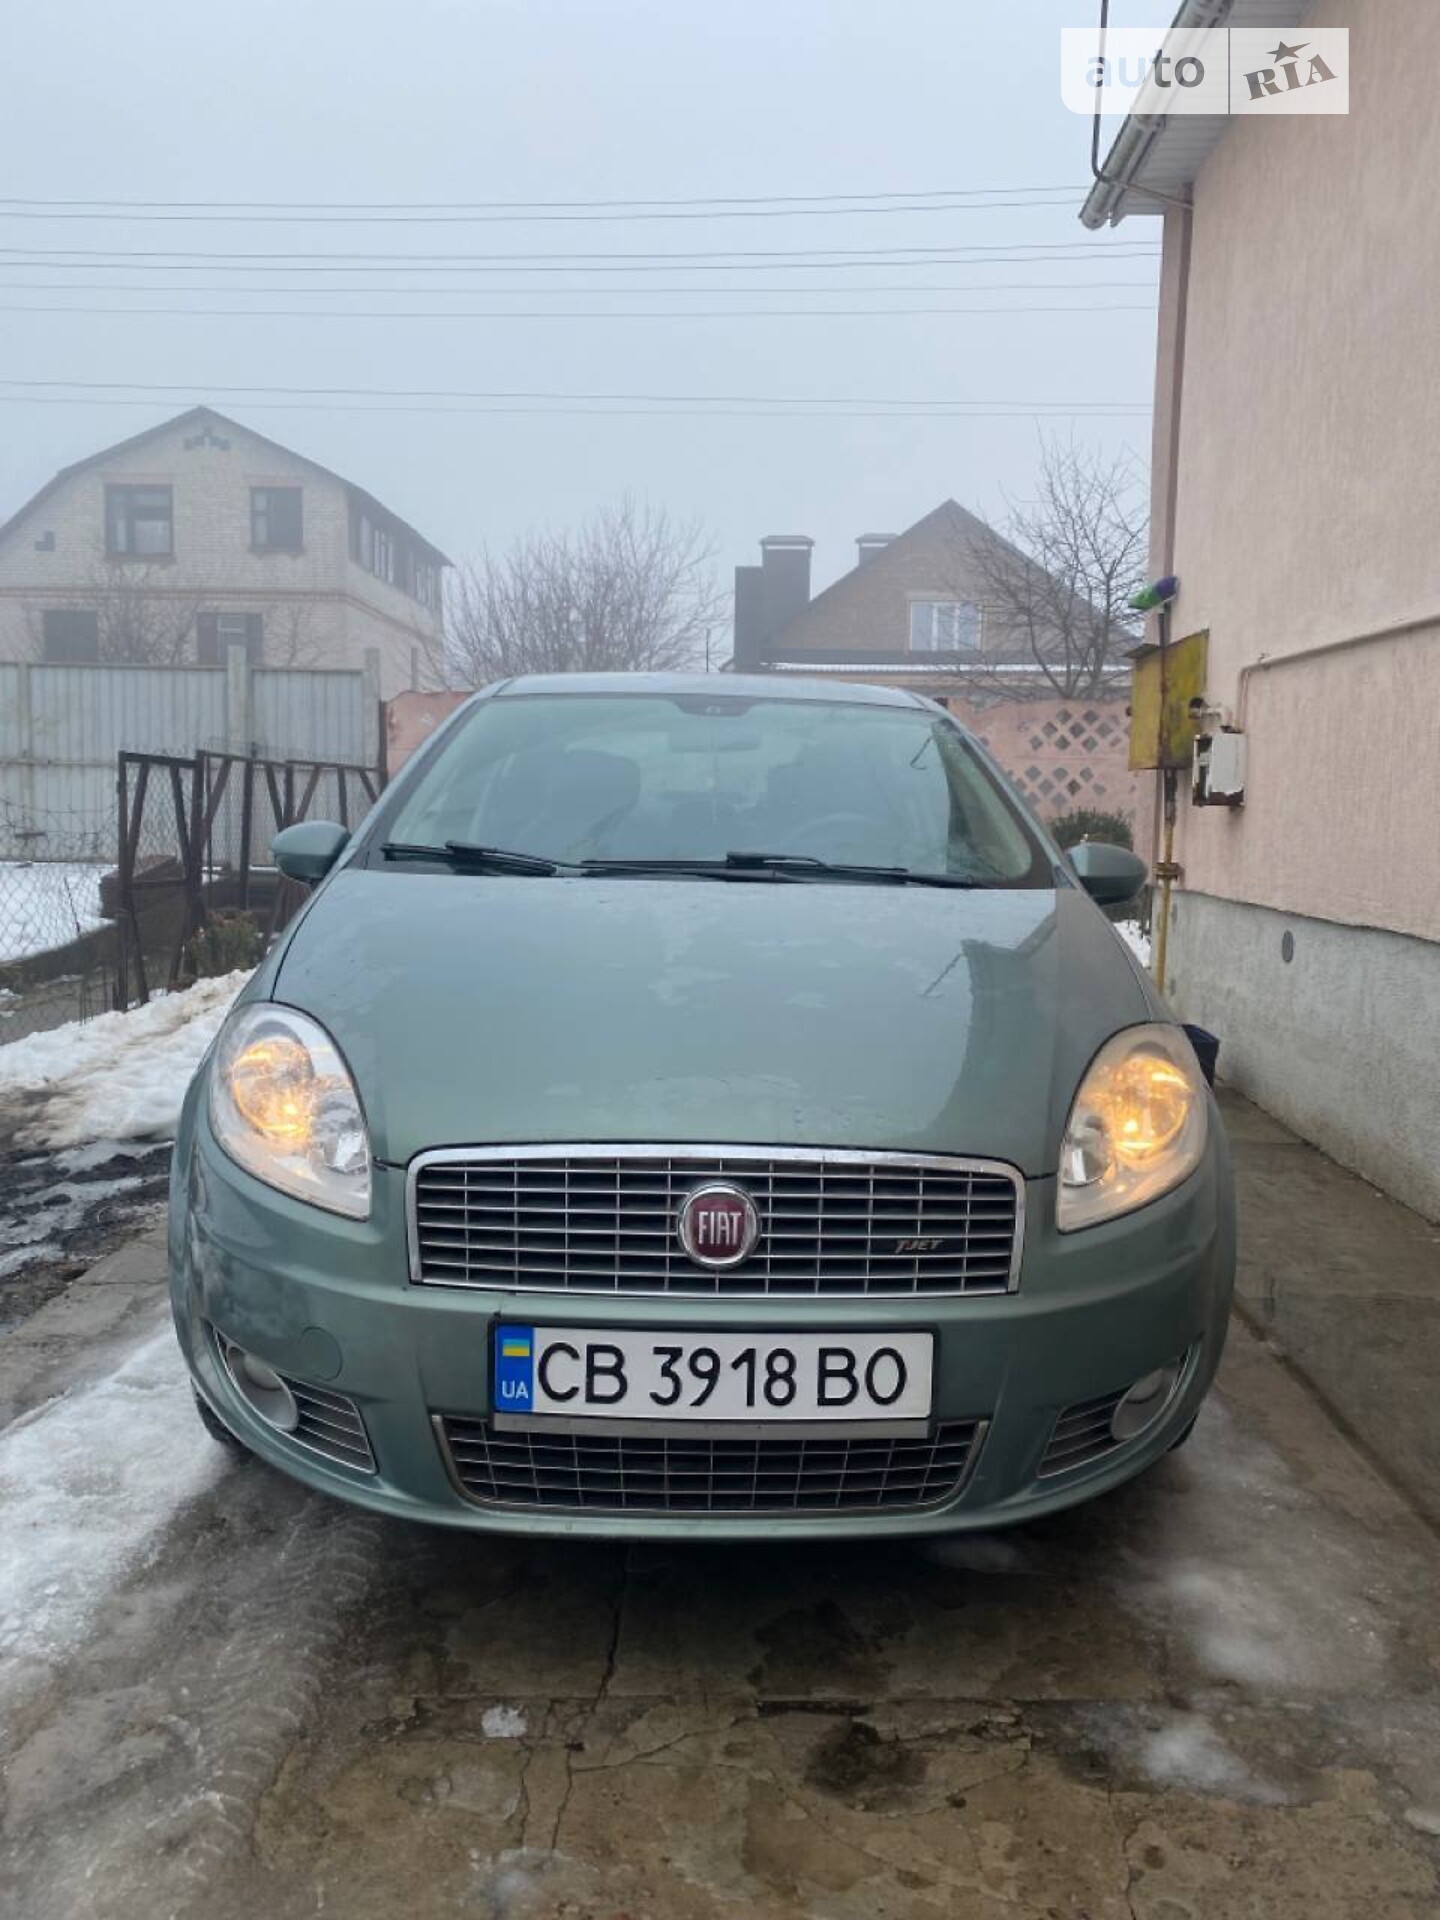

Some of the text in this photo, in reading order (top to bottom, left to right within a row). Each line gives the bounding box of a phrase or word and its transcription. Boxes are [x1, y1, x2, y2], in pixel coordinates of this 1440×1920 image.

[697, 1210, 743, 1246] FIAT
[502, 1379, 529, 1399] UA
[537, 1341, 908, 1408] CB 3918 BO
